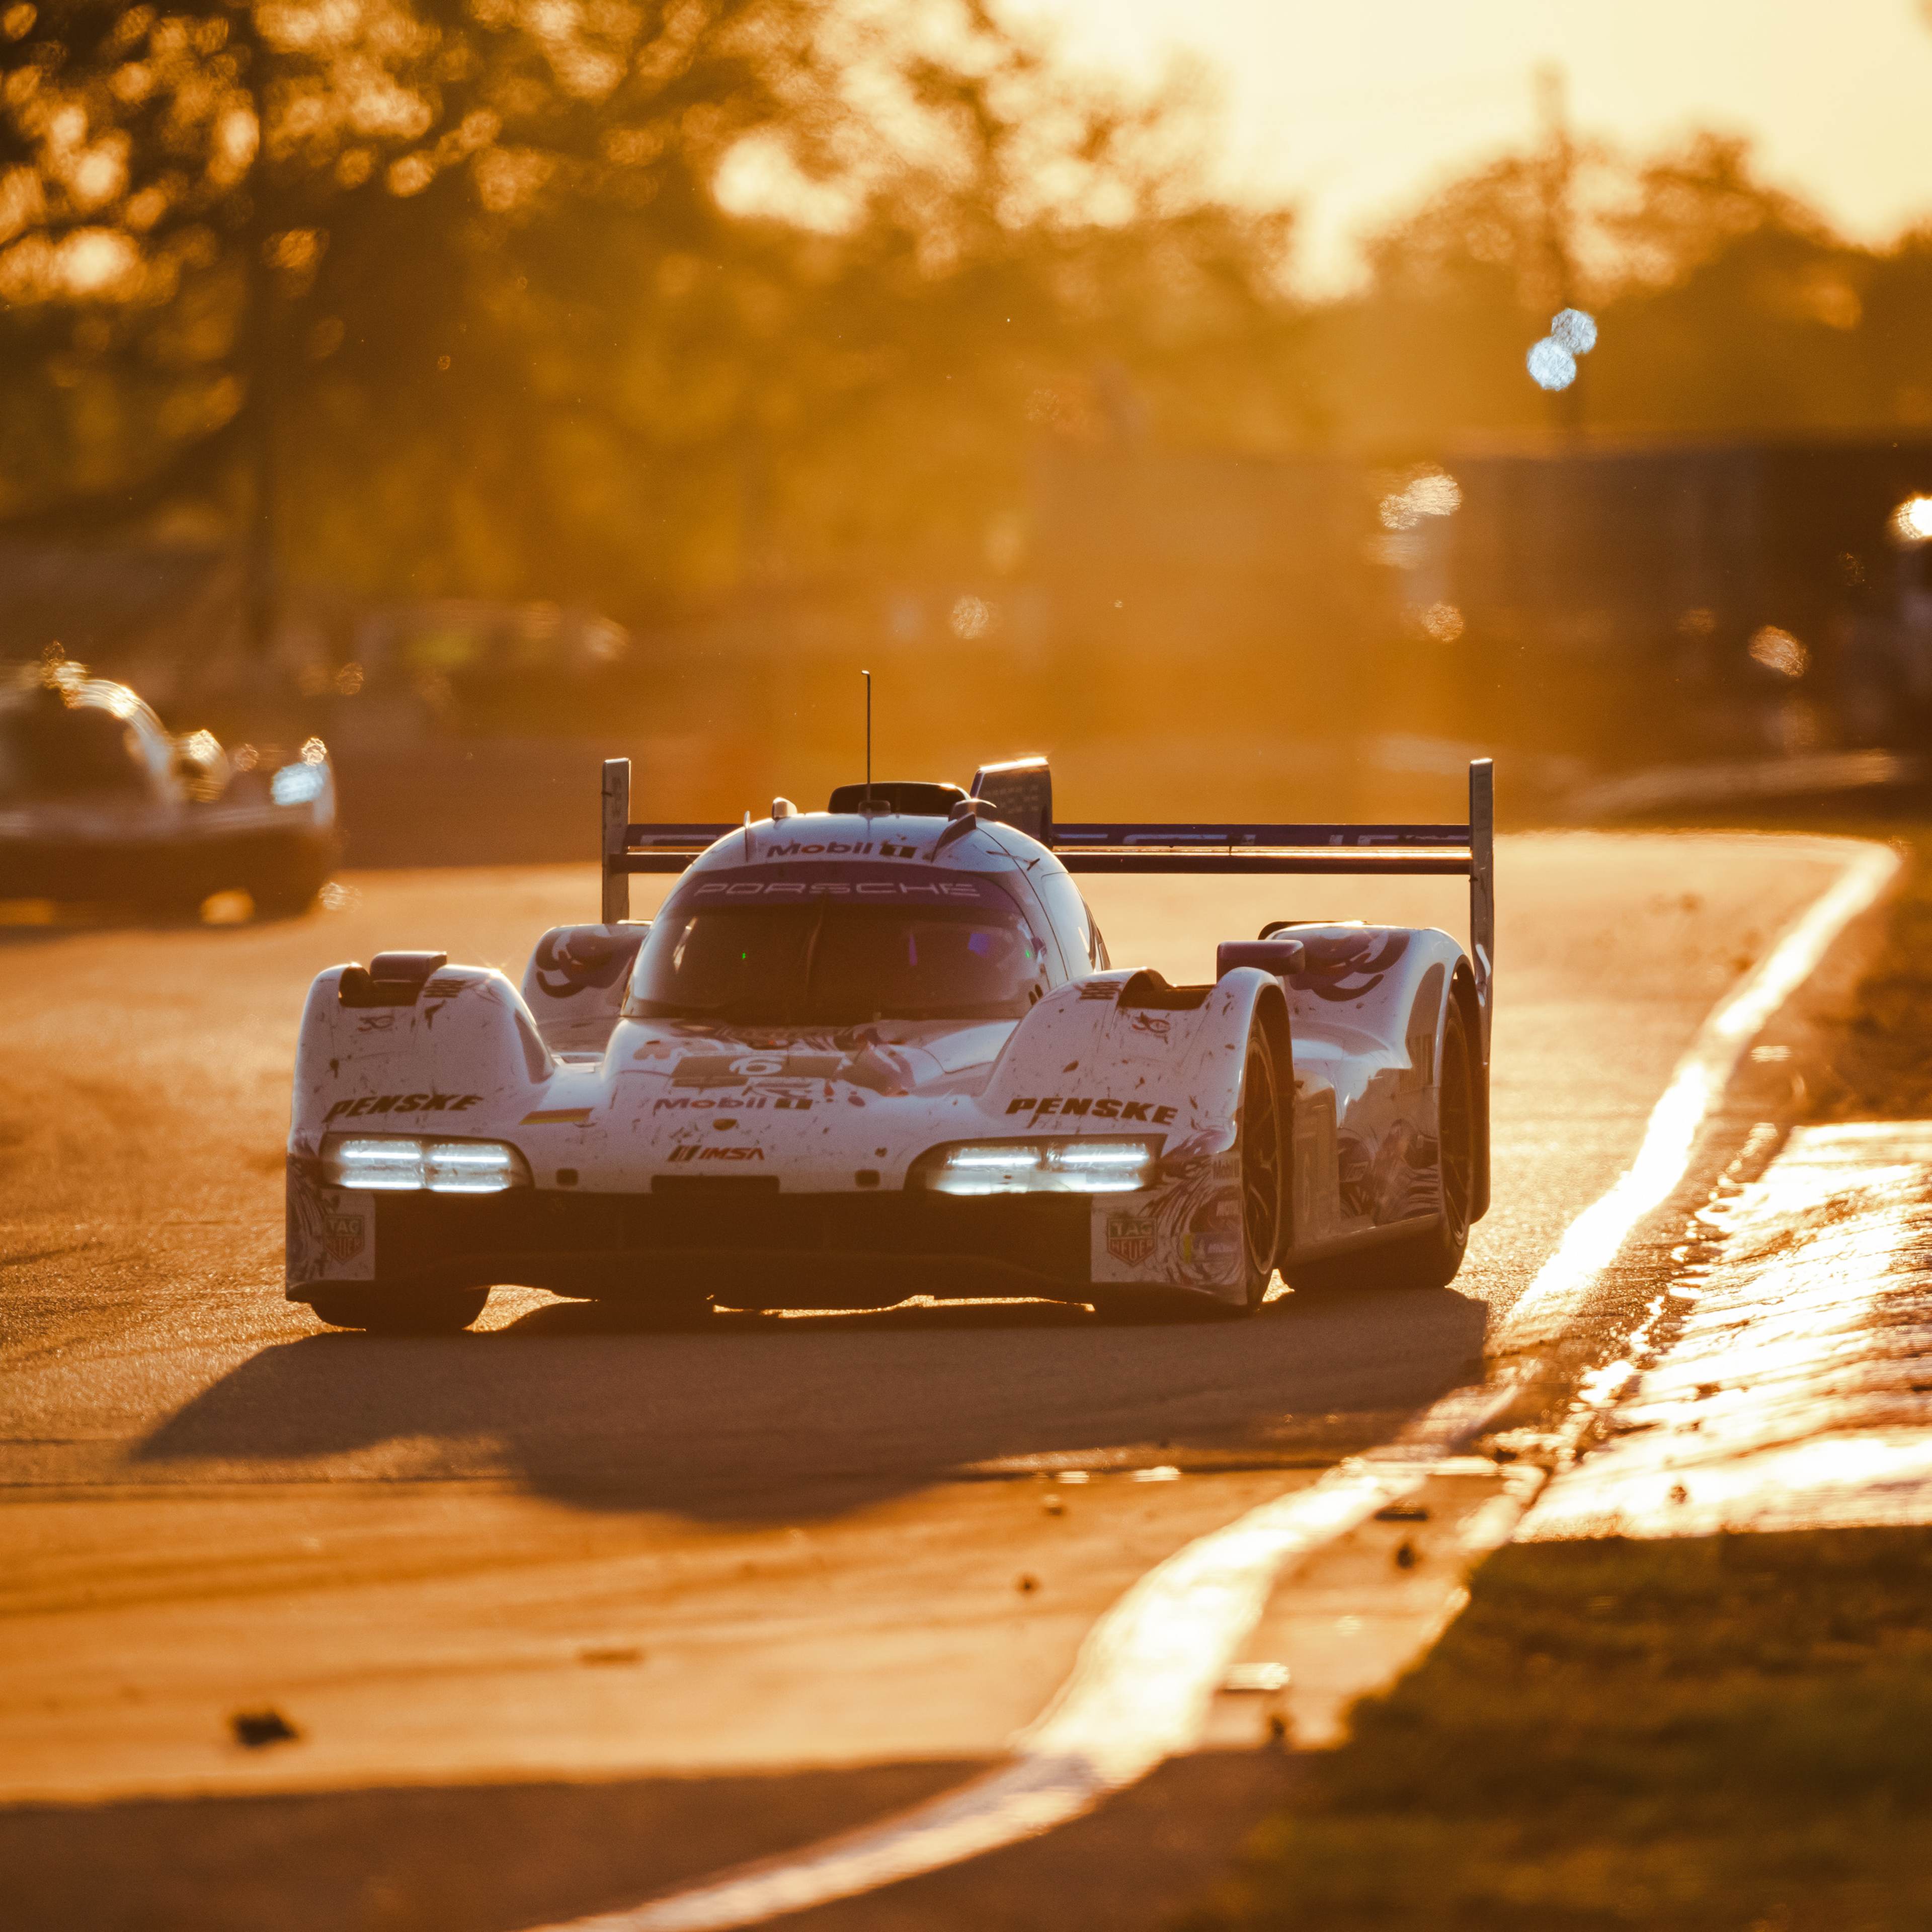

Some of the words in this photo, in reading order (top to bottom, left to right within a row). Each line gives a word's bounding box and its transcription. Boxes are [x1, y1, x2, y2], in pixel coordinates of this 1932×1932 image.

[767, 841, 873, 857] Mobil
[694, 882, 981, 897] PORSCHE
[729, 1056, 783, 1076] 6
[321, 1093, 484, 1123] PENSKE
[654, 1097, 767, 1109] Mobil
[1005, 1097, 1178, 1125] PENSKE
[699, 1147, 765, 1160] IMSA
[1111, 1222, 1152, 1236] TAG
